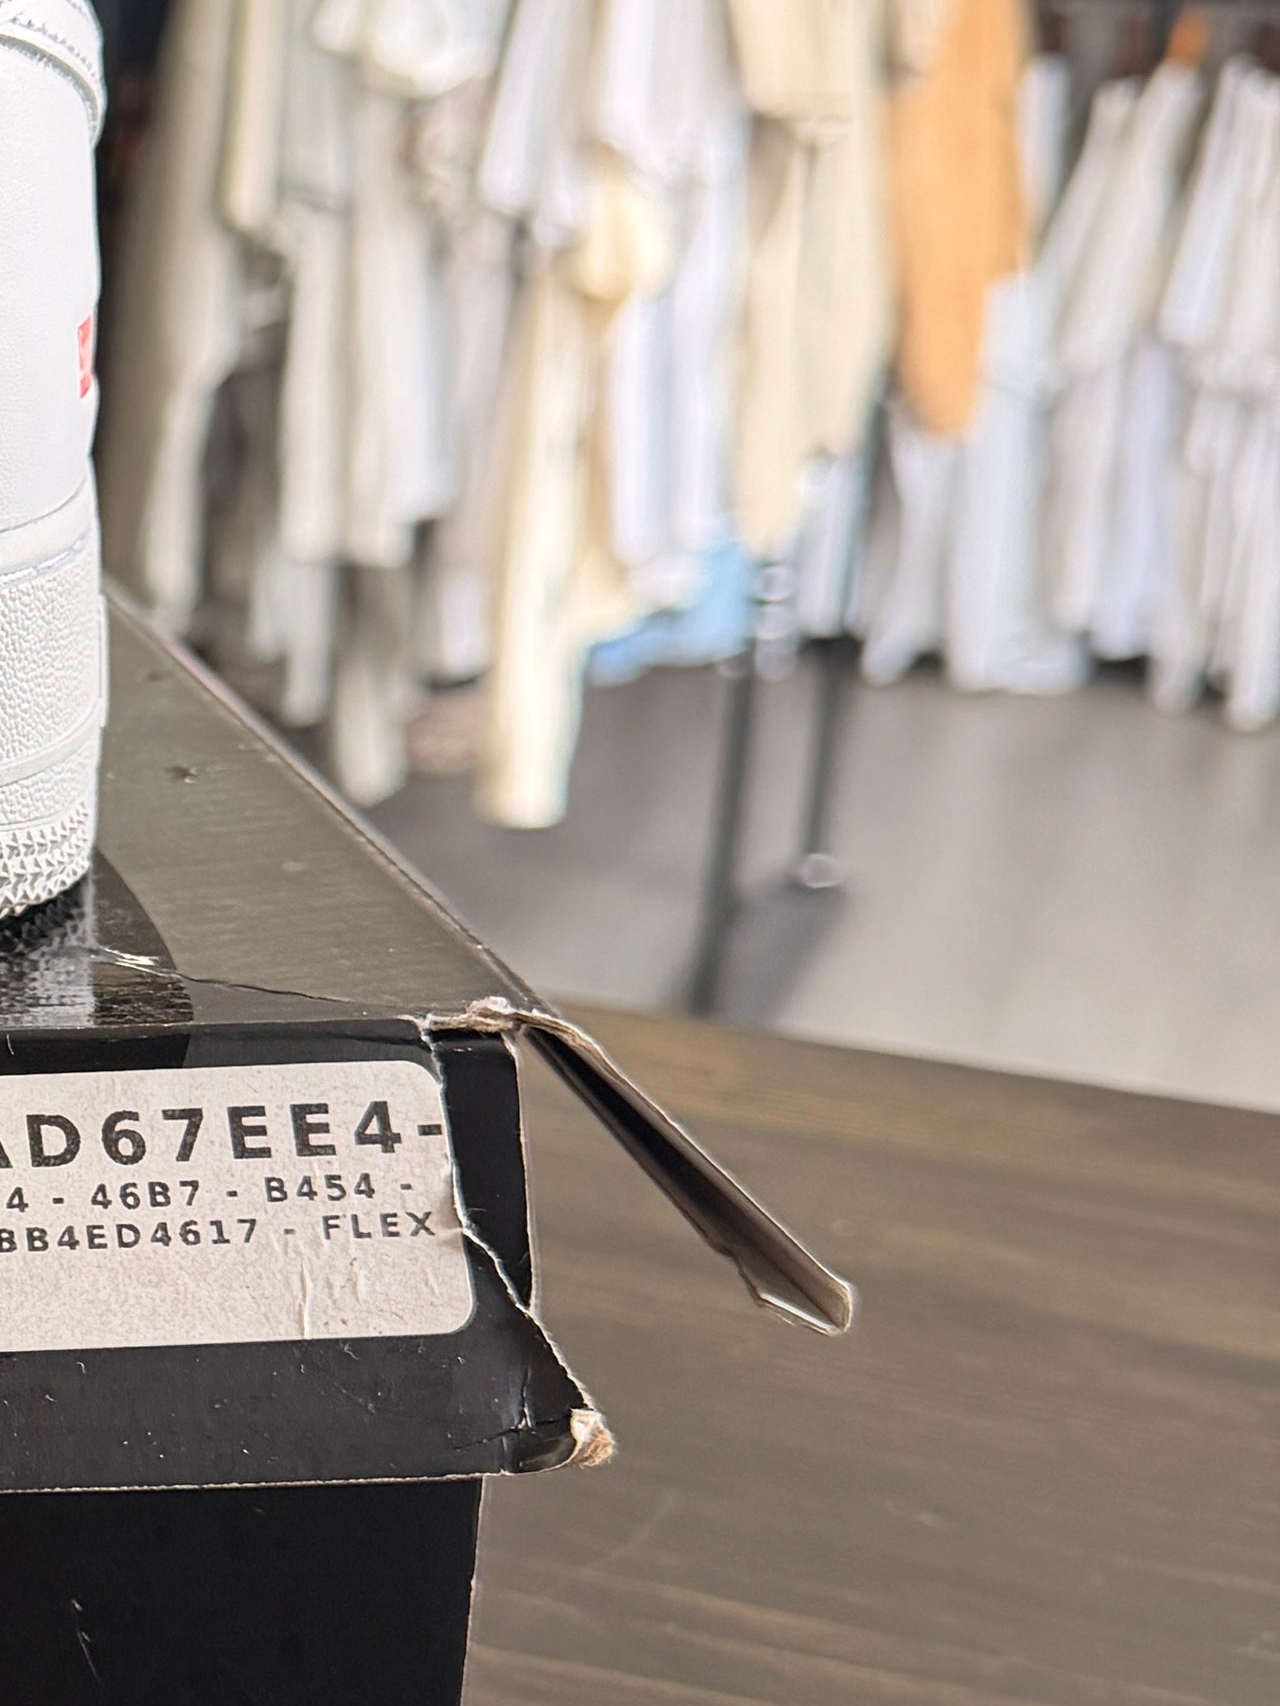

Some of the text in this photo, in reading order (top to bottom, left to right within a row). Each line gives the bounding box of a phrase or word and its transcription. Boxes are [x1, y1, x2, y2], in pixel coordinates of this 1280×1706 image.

[90, 1179, 200, 1210] 46B7
[264, 1172, 376, 1203] B454
[322, 1211, 436, 1240] FLEX
